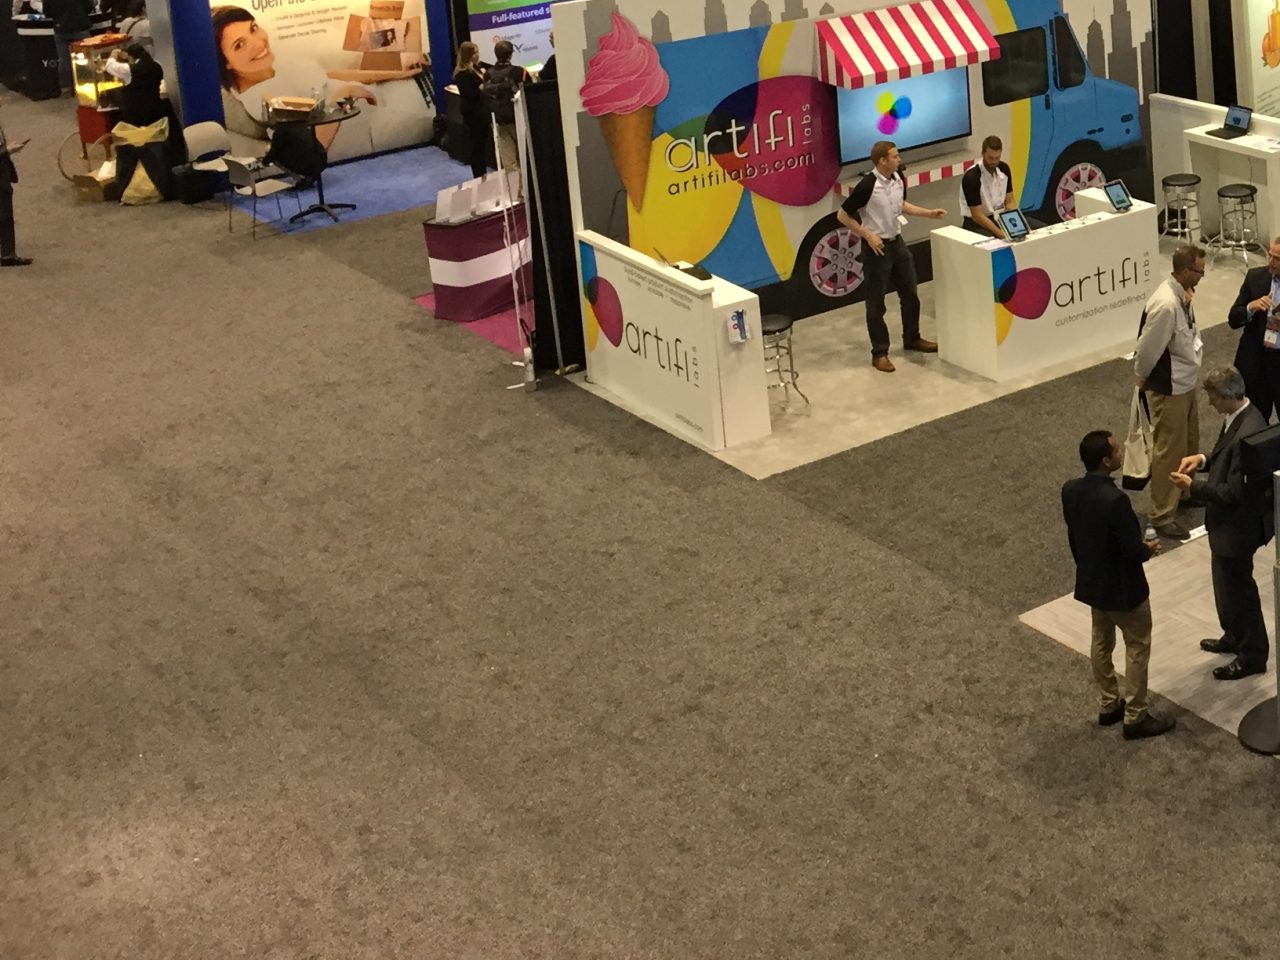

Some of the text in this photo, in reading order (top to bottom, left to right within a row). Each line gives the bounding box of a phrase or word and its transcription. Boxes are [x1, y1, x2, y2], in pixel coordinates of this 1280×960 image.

[492, 7, 545, 24] Full-featured
[665, 103, 812, 172] artifi labs
[668, 152, 815, 196] artifilabs.com
[1053, 257, 1138, 308] artifi
[1055, 304, 1108, 327] customization
[625, 322, 690, 382] artifi
